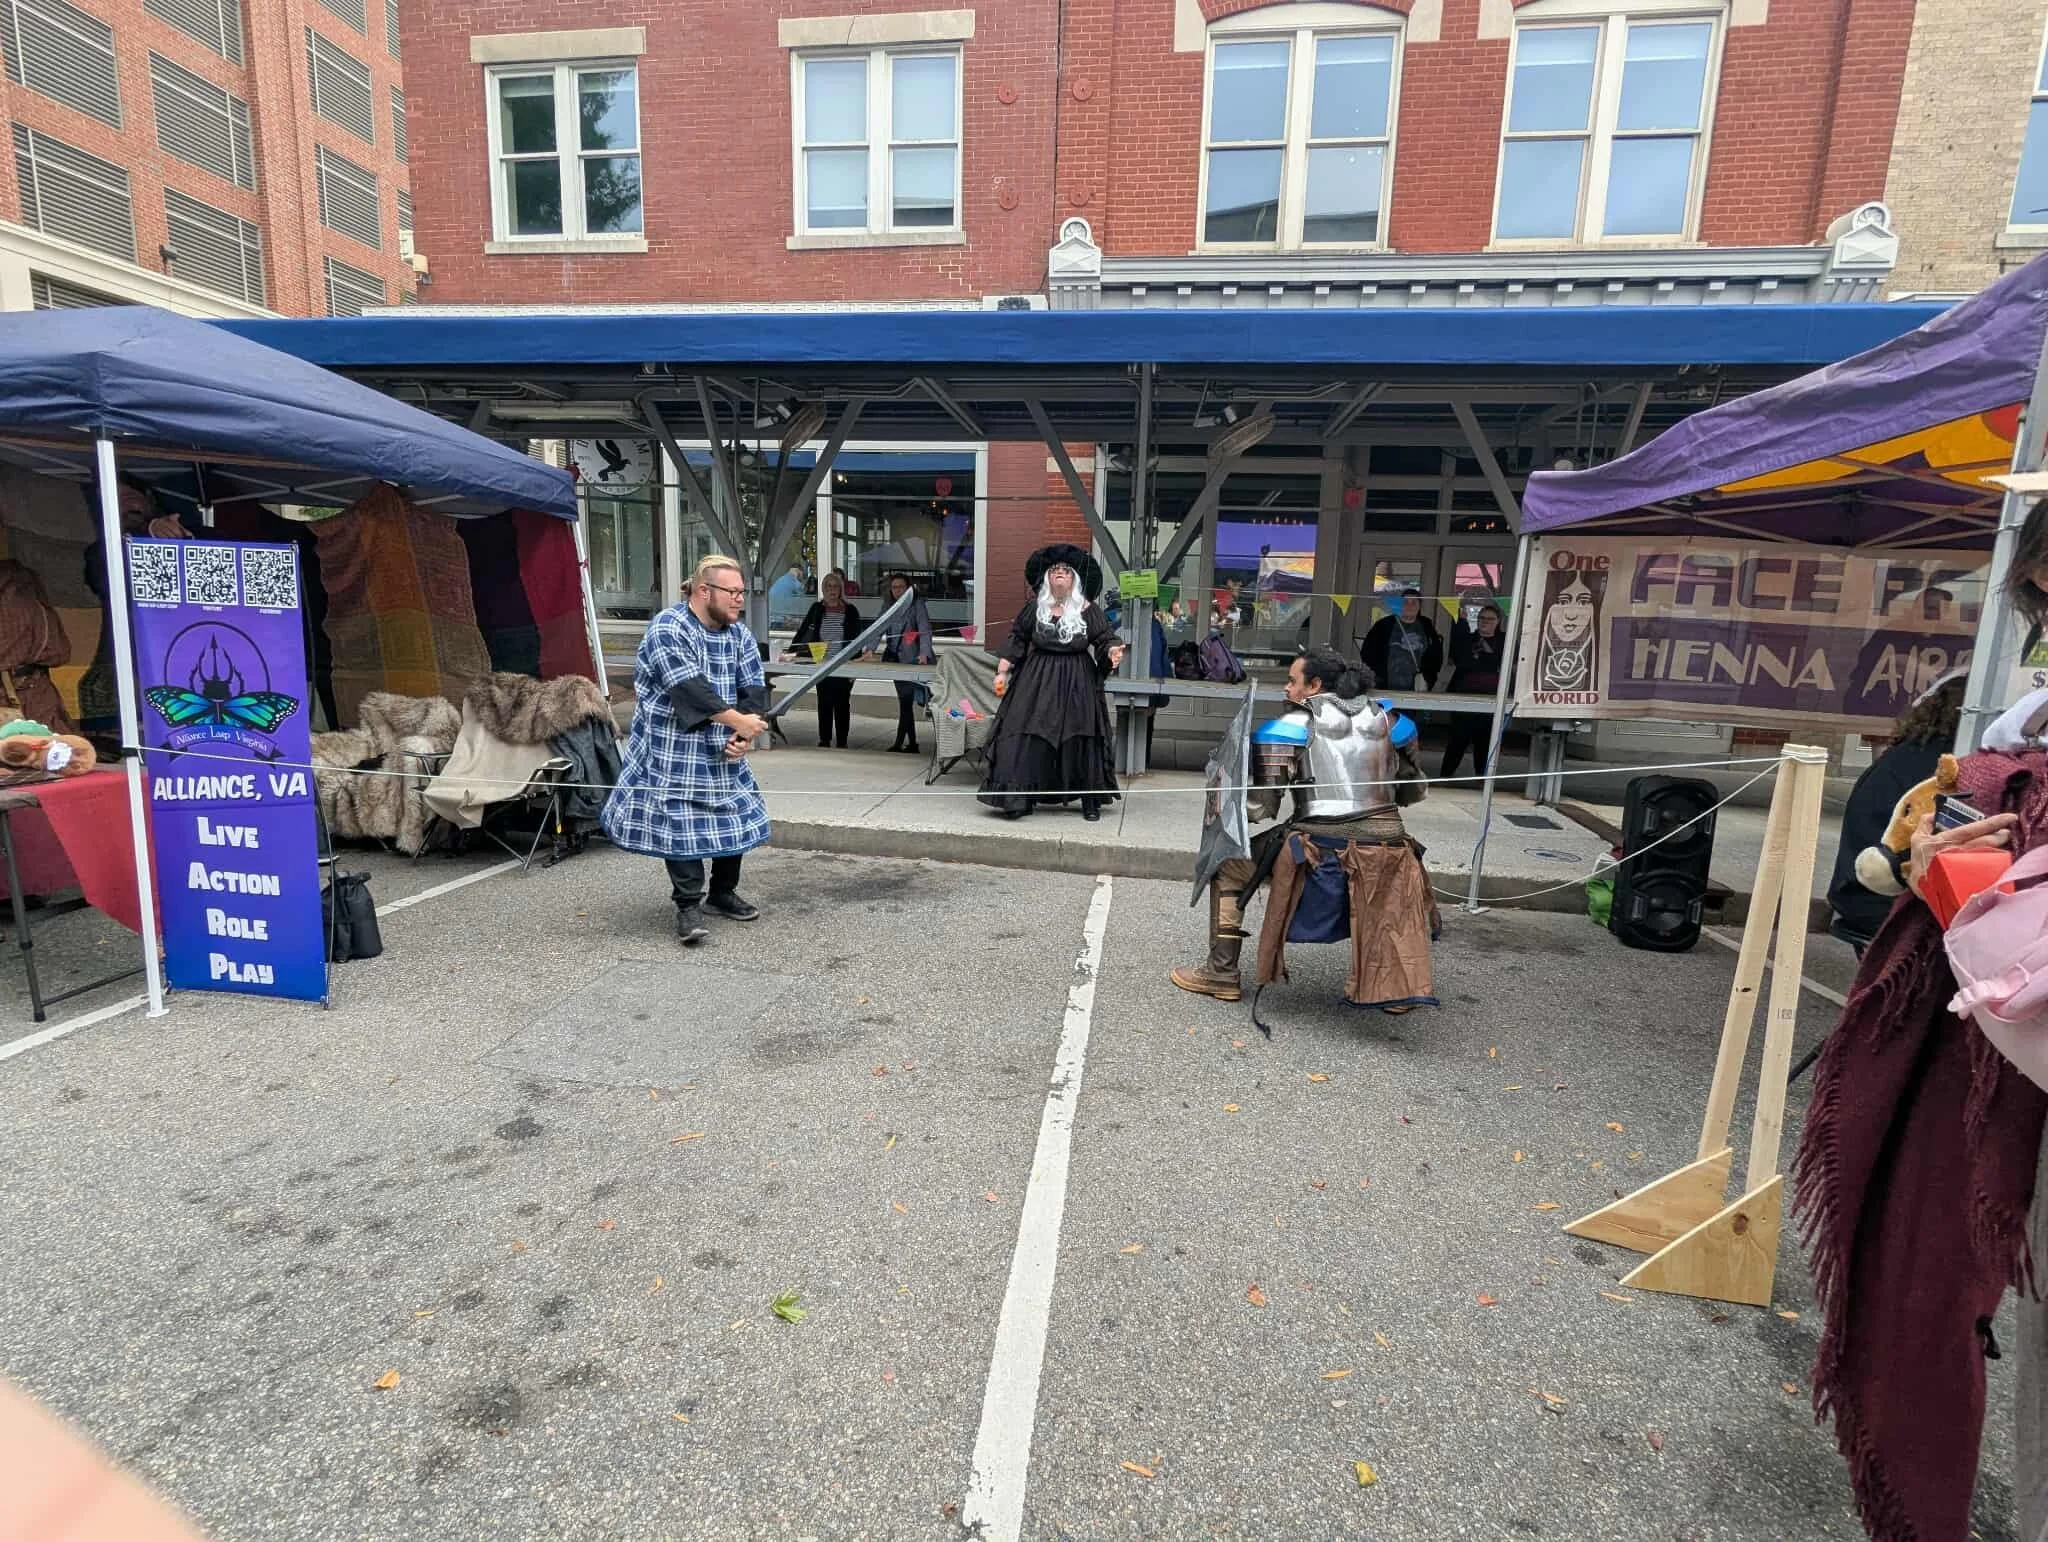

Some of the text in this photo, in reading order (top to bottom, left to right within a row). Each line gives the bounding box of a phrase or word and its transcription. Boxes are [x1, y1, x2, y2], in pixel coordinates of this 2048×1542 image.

[1550, 550, 1610, 570] One
[1630, 554, 1844, 613] FACE
[1632, 638, 1835, 691] HENNA
[1533, 691, 1599, 705] WORLD
[153, 771, 308, 801] ALLIANCE, VA
